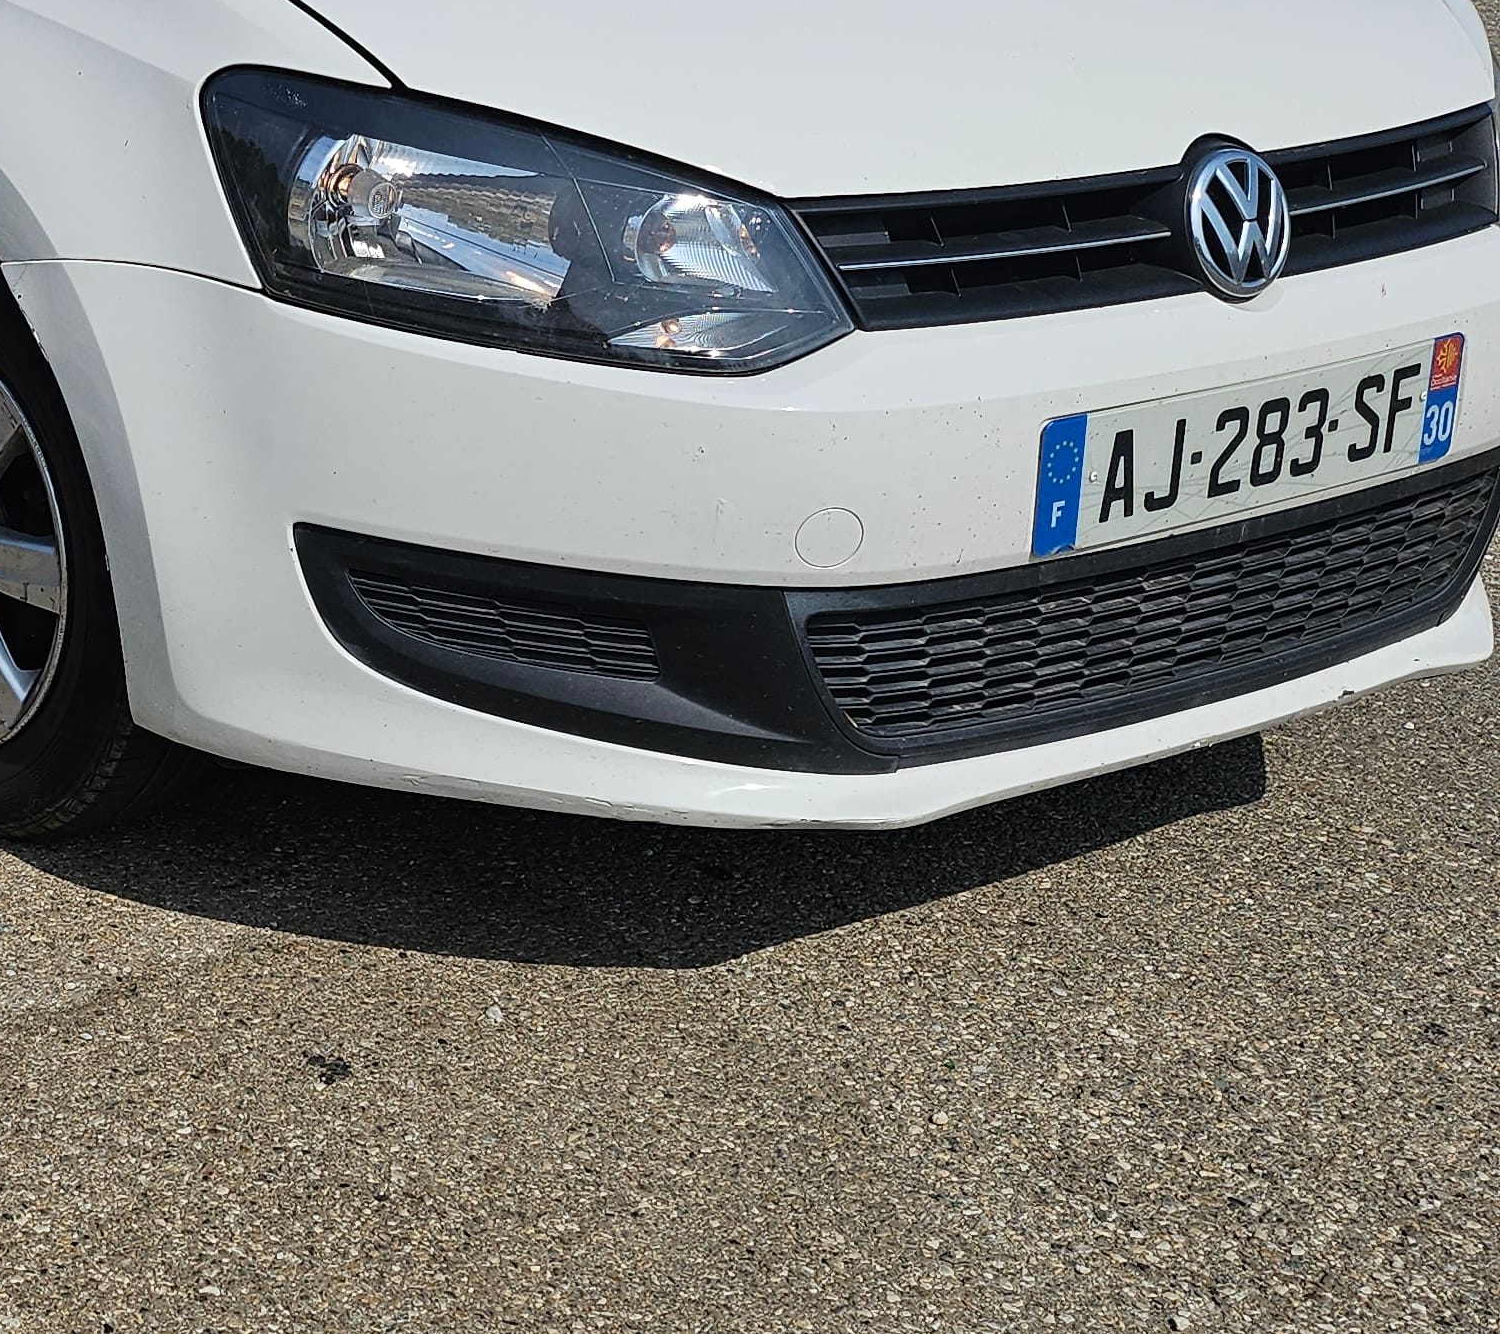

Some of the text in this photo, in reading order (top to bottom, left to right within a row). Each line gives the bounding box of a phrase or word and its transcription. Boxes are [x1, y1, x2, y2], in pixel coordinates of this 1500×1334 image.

[1097, 362, 1422, 524] AJ-283-SF
[1423, 400, 1454, 446] 30
[1050, 499, 1066, 530] F
